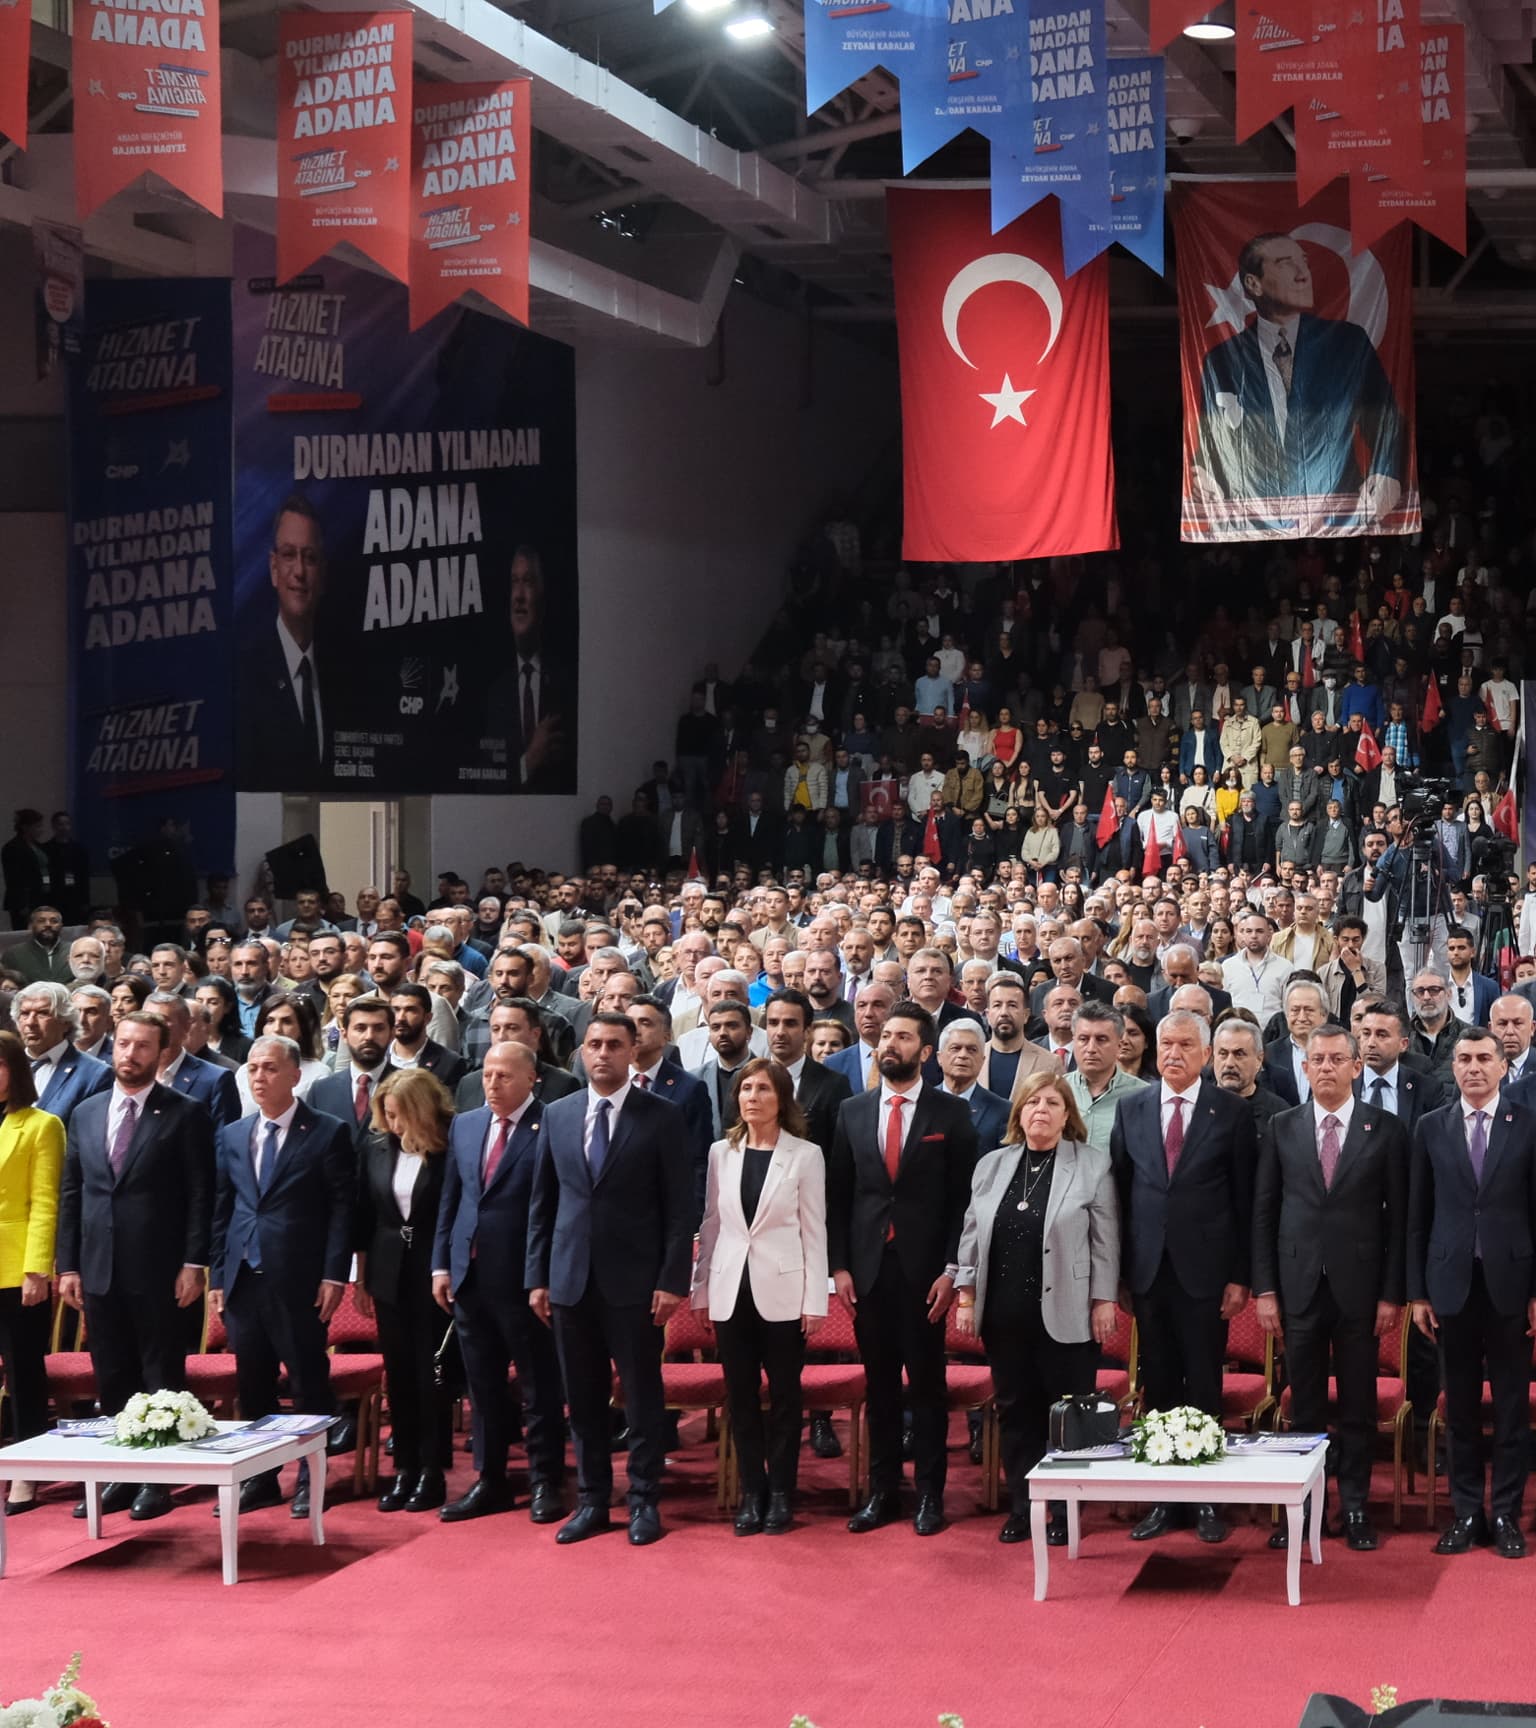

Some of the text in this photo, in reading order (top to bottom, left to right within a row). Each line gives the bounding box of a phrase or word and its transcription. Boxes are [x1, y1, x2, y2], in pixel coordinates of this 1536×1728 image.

[947, 0, 1014, 25] ANA
[286, 23, 394, 58] DURMADAN
[842, 41, 916, 51] ZEYDAN KARALAR
[294, 44, 392, 76] YILMADAN
[1272, 73, 1343, 82] ZEYDAN KARALAR
[294, 65, 396, 108] ADANA
[294, 96, 396, 139] ADANA
[414, 91, 514, 125] DURMADAN
[421, 110, 512, 141] YILMADAN
[422, 128, 516, 169] ADANA
[422, 157, 516, 197] ADANA
[1021, 174, 1081, 183] ZEYDAN KARALAR
[312, 217, 377, 227] ZEYDAN KARALAR
[440, 267, 502, 278] ZEYDAN KARALAR
[294, 427, 540, 480] DURMADAN YILMADAN
[105, 464, 139, 479] CHP
[73, 501, 214, 546] DURMADAN
[363, 482, 483, 554] ADANA
[83, 529, 211, 571] YILMADAN
[84, 557, 216, 610] ADANA
[363, 554, 483, 632] ADANA
[84, 597, 216, 651] ADANA
[400, 696, 424, 714] CHP
